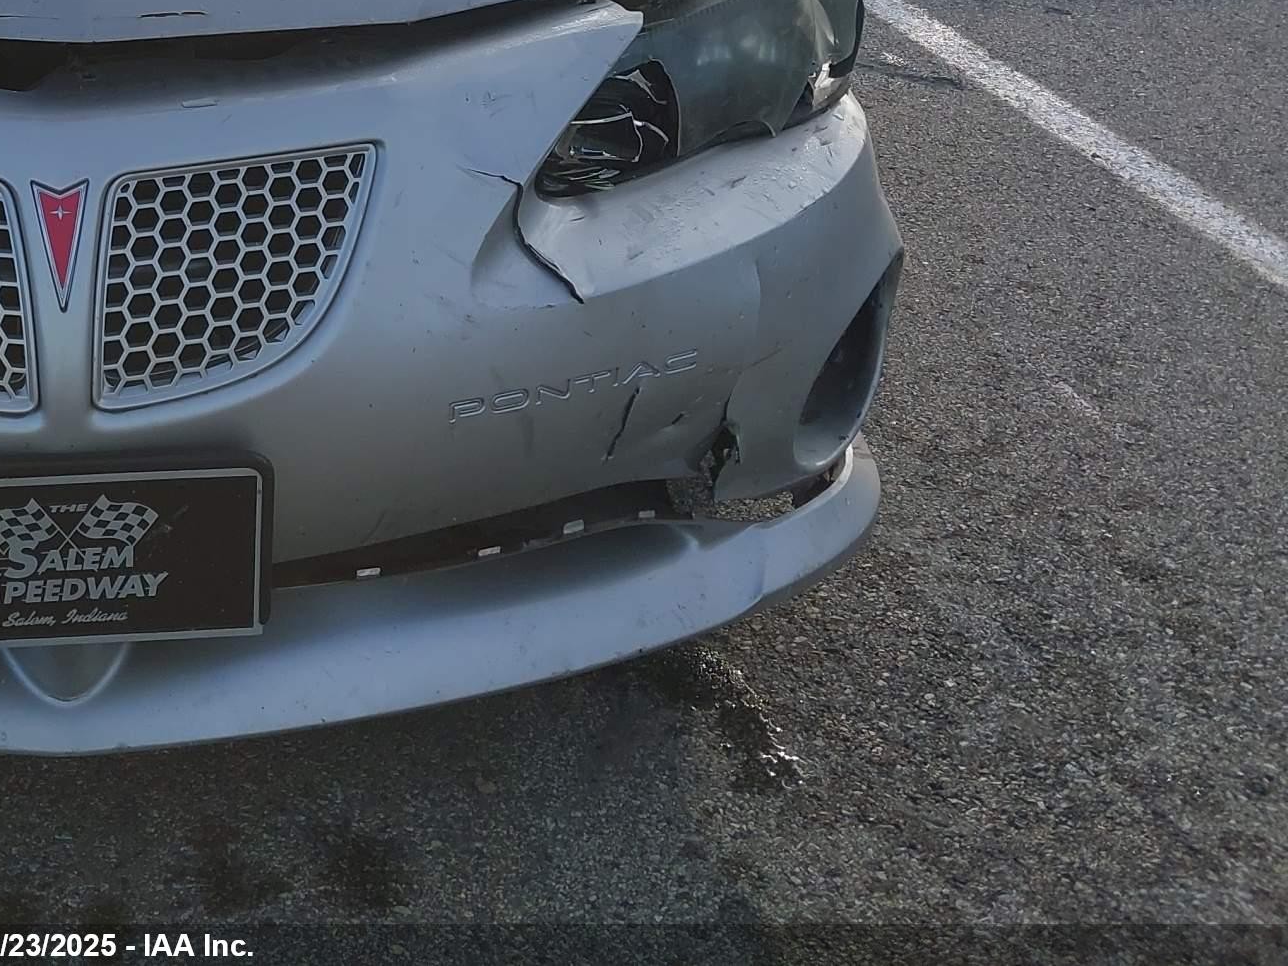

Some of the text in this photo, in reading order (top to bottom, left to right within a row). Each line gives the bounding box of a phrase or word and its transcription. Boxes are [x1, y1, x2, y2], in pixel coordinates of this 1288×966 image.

[448, 348, 698, 423] PONTIAC
[49, 503, 89, 513] THE
[2, 606, 129, 627] Salem, Indiana
